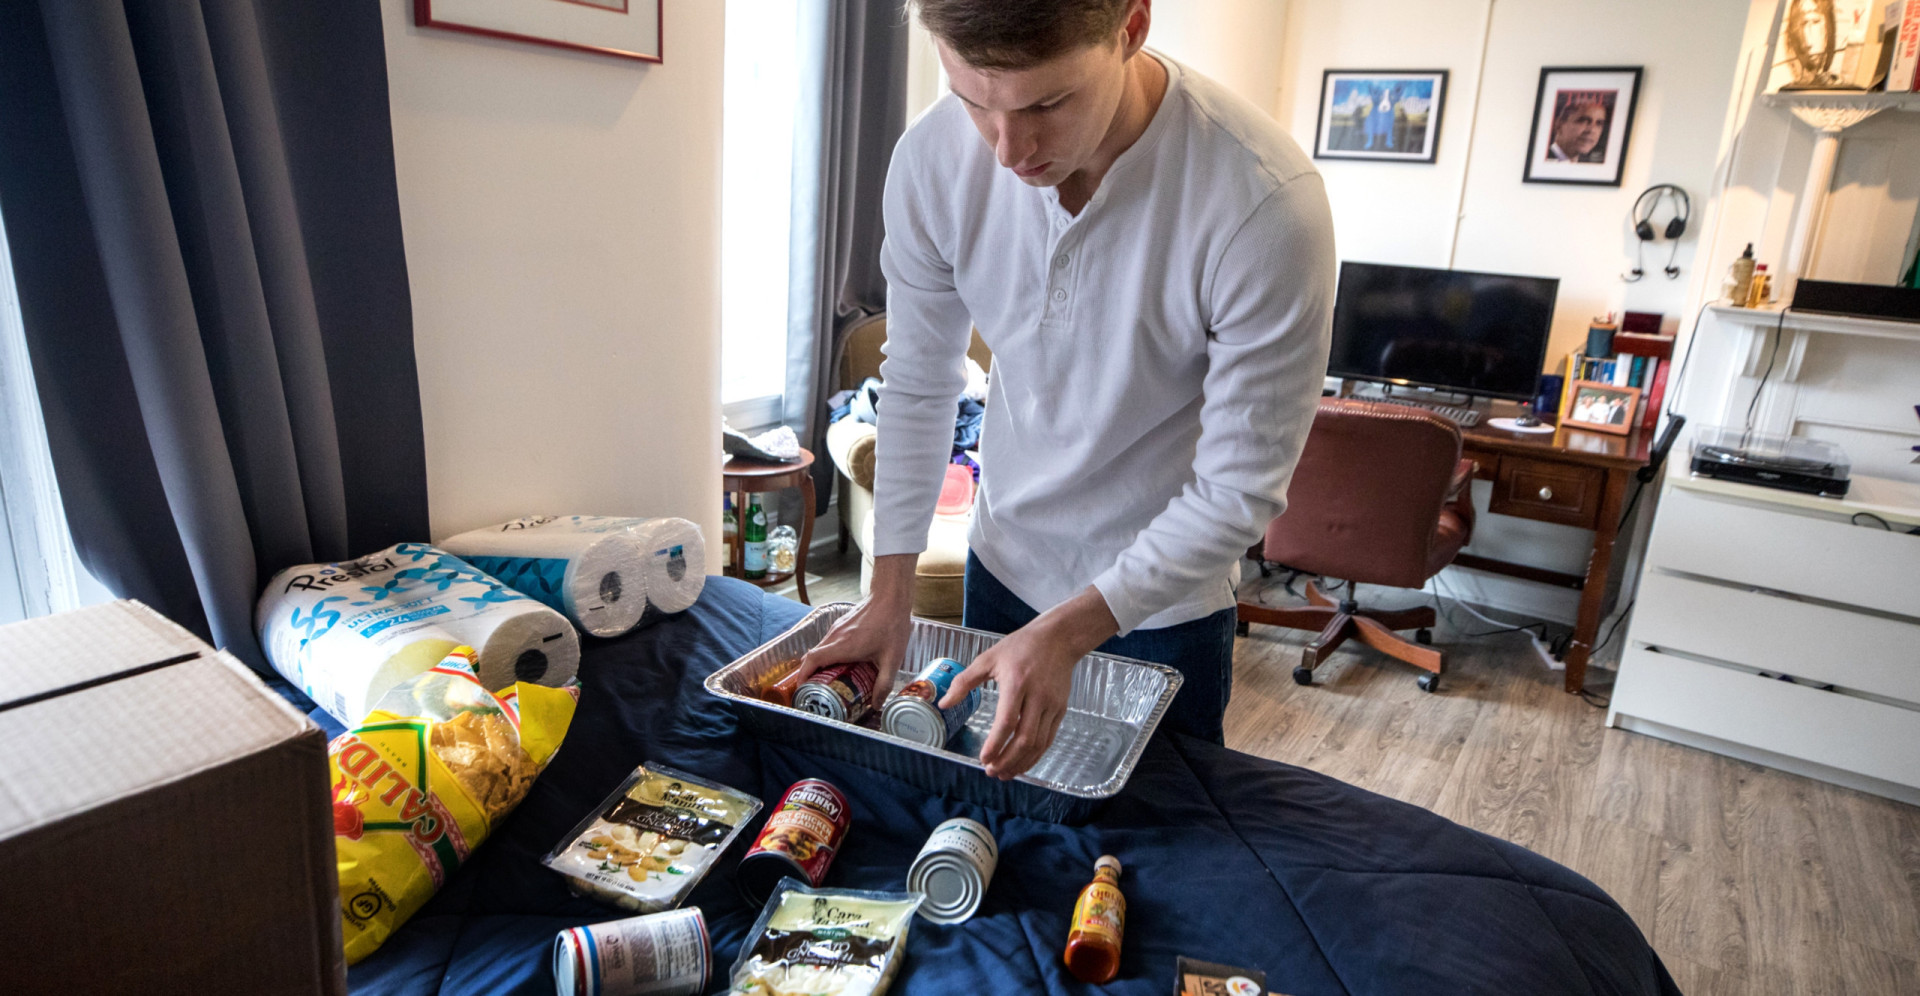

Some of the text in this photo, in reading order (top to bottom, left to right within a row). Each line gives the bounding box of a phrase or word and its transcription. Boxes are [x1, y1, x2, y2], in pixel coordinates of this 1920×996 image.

[284, 557, 396, 594] Presto!
[785, 790, 839, 817] CHUNKY
[794, 811, 832, 836] CHICKEN
[355, 897, 374, 914] GF
[827, 906, 862, 920] Cara
